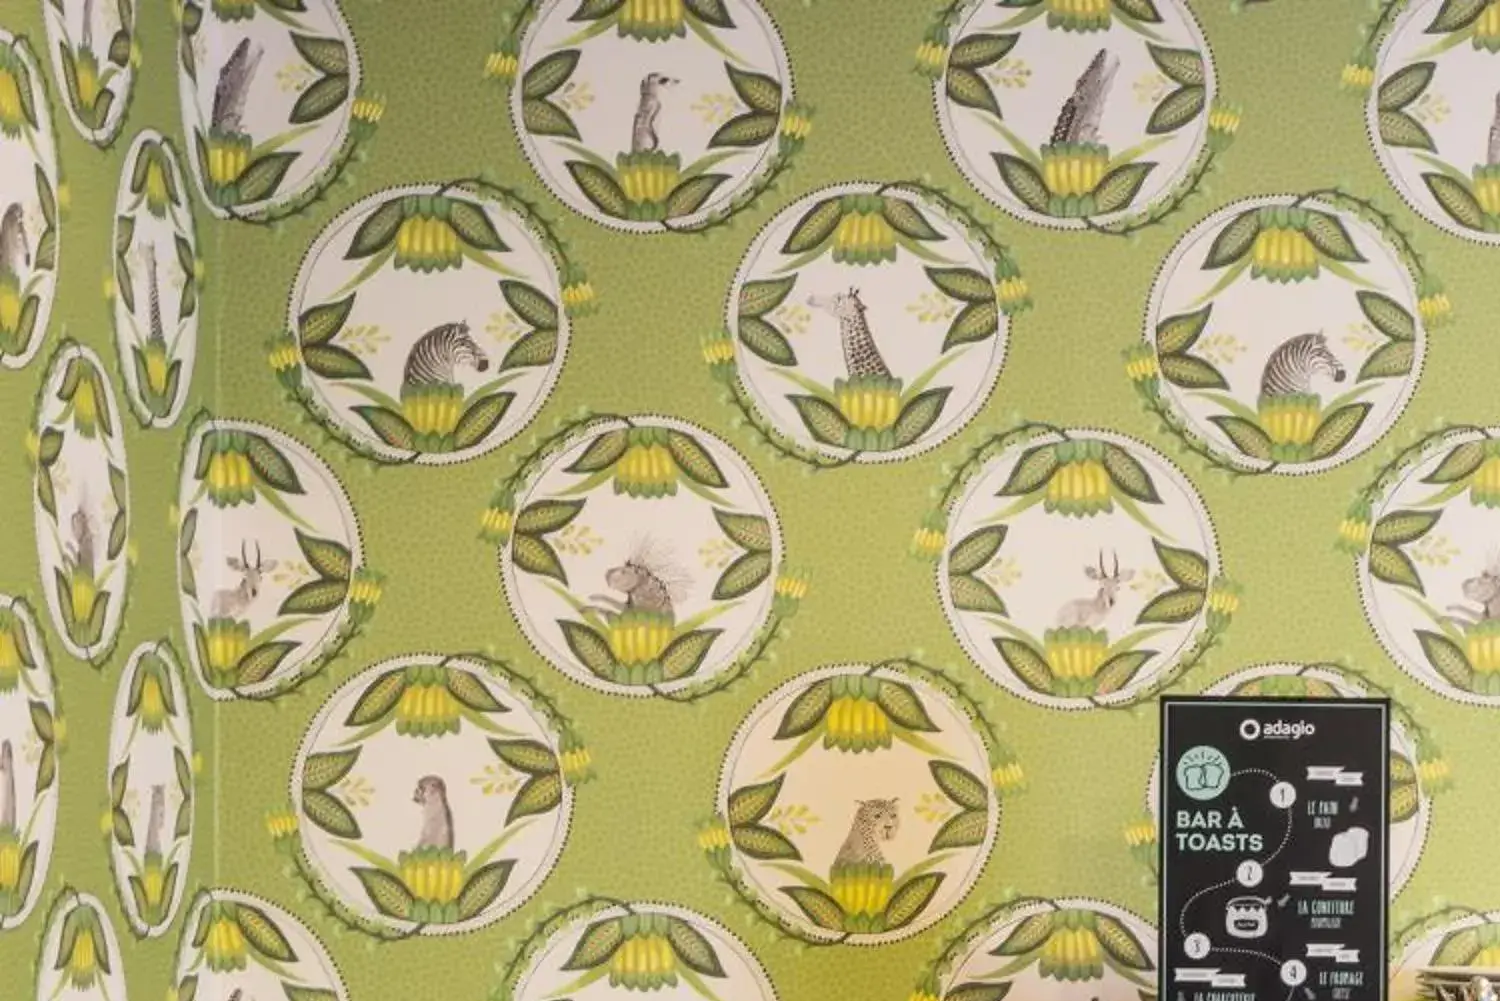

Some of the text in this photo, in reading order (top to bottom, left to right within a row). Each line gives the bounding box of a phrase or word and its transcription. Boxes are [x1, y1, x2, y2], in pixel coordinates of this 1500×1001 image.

[1263, 719, 1316, 740] adagio
[1176, 810, 1222, 829] BAR
[1175, 833, 1264, 852] TOASTS
